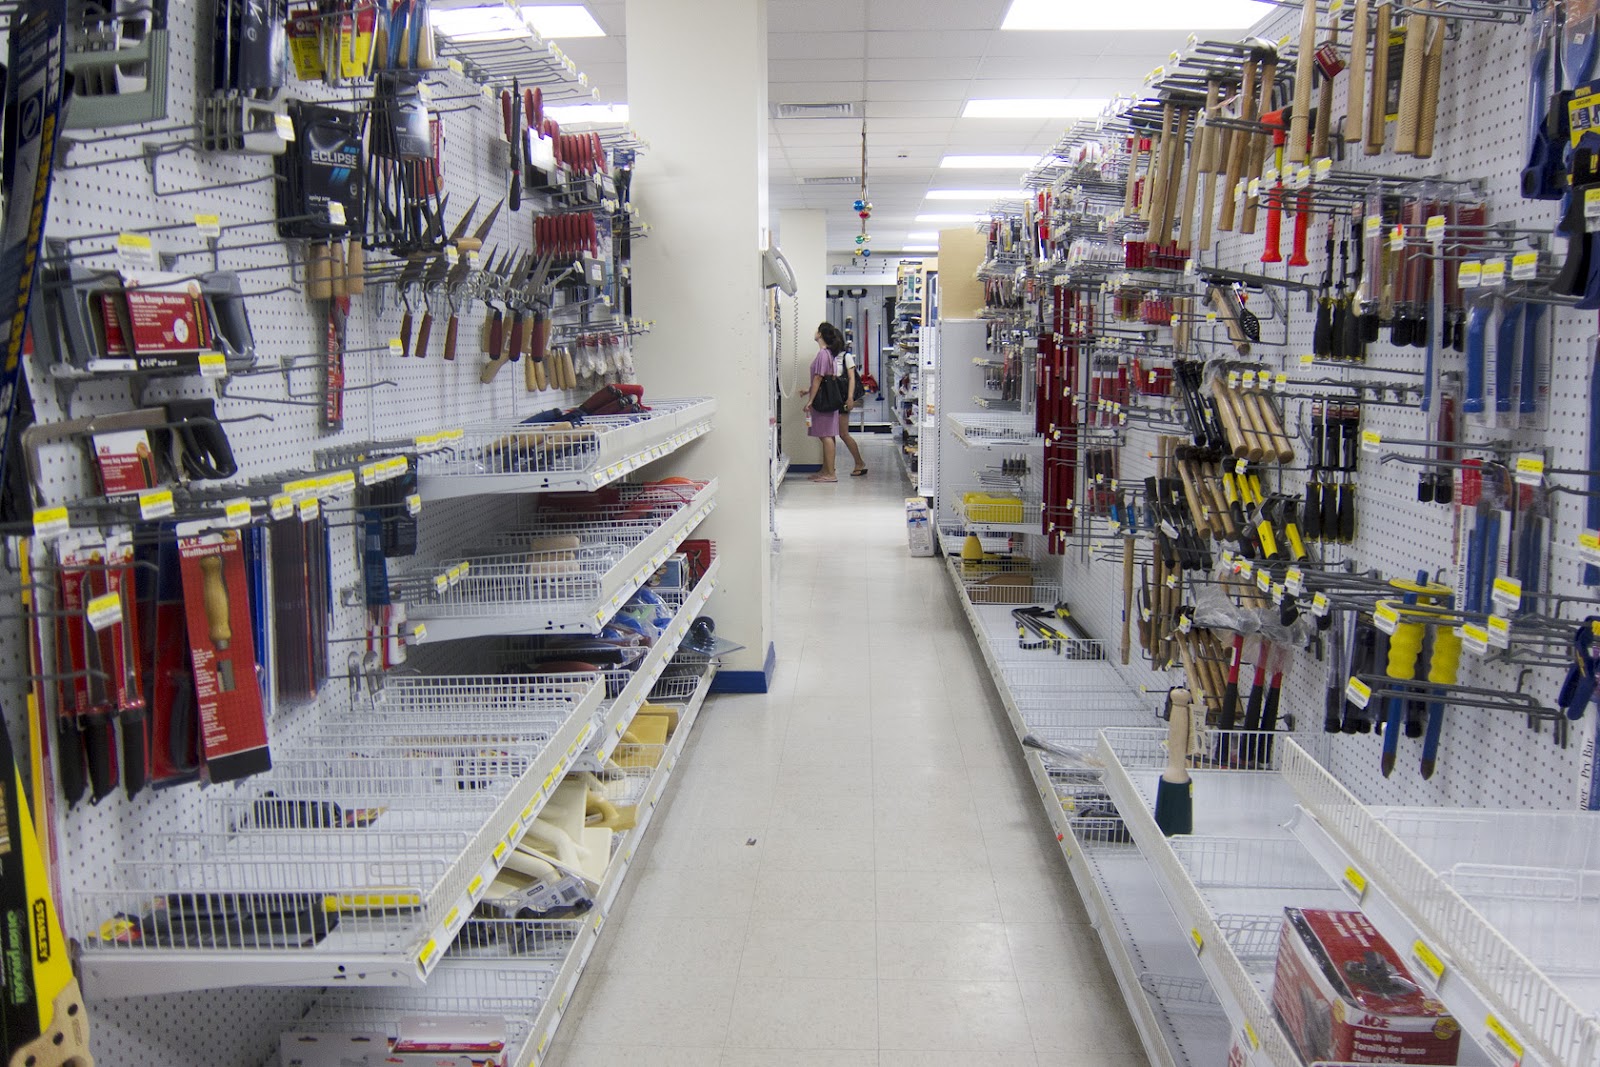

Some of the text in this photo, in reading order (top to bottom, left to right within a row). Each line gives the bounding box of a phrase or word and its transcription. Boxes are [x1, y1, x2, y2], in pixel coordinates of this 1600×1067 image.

[311, 150, 357, 165] ECLIPSE
[180, 536, 203, 549] ACE
[182, 544, 237, 558] Wallboard Saw
[1582, 738, 1593, 758] Bar
[34, 900, 49, 961] STANLEY
[1358, 1015, 1390, 1028] ACE
[1355, 1031, 1402, 1043] Bench Vise
[1353, 1041, 1426, 1054] Tornillo de banco
